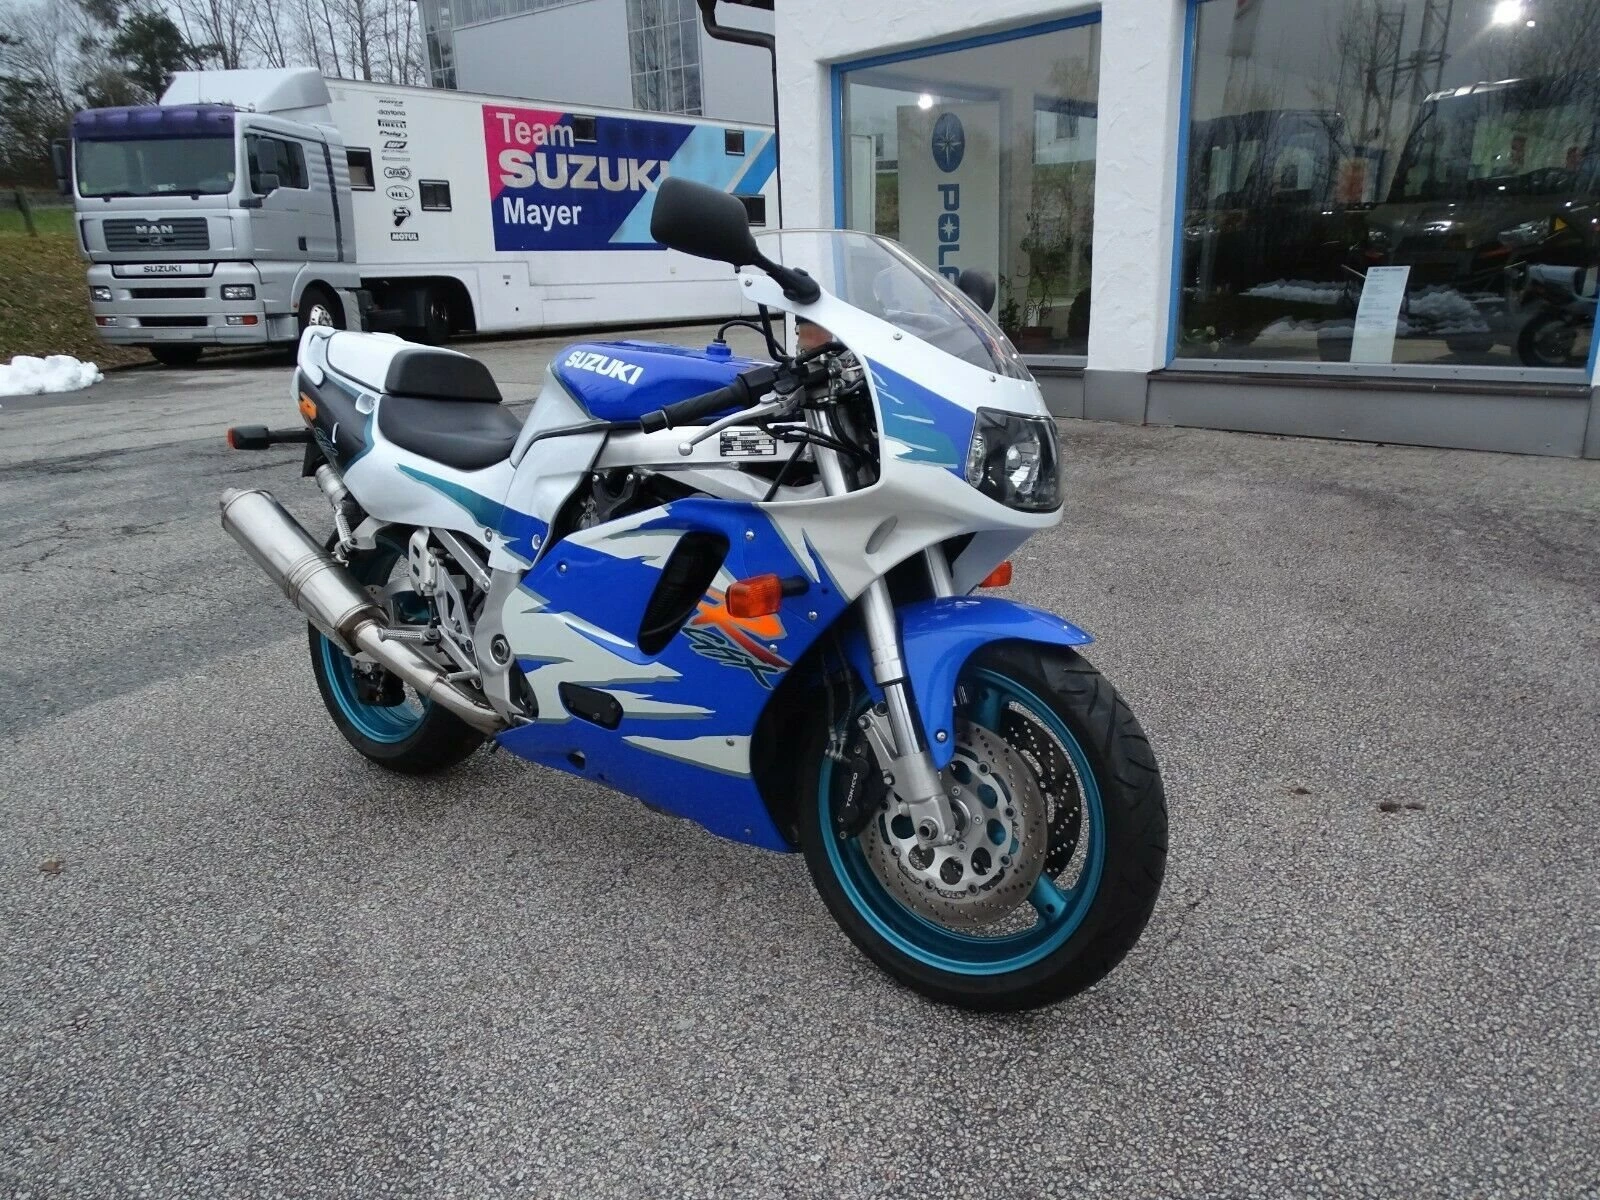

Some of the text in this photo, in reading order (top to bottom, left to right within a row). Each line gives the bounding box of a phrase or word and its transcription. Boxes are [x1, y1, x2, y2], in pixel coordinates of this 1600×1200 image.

[496, 112, 575, 147] Team
[135, 225, 174, 234] MAN
[502, 197, 583, 232] Mayer
[564, 350, 644, 386] SUZUKI
[845, 772, 858, 807] TOKICO
